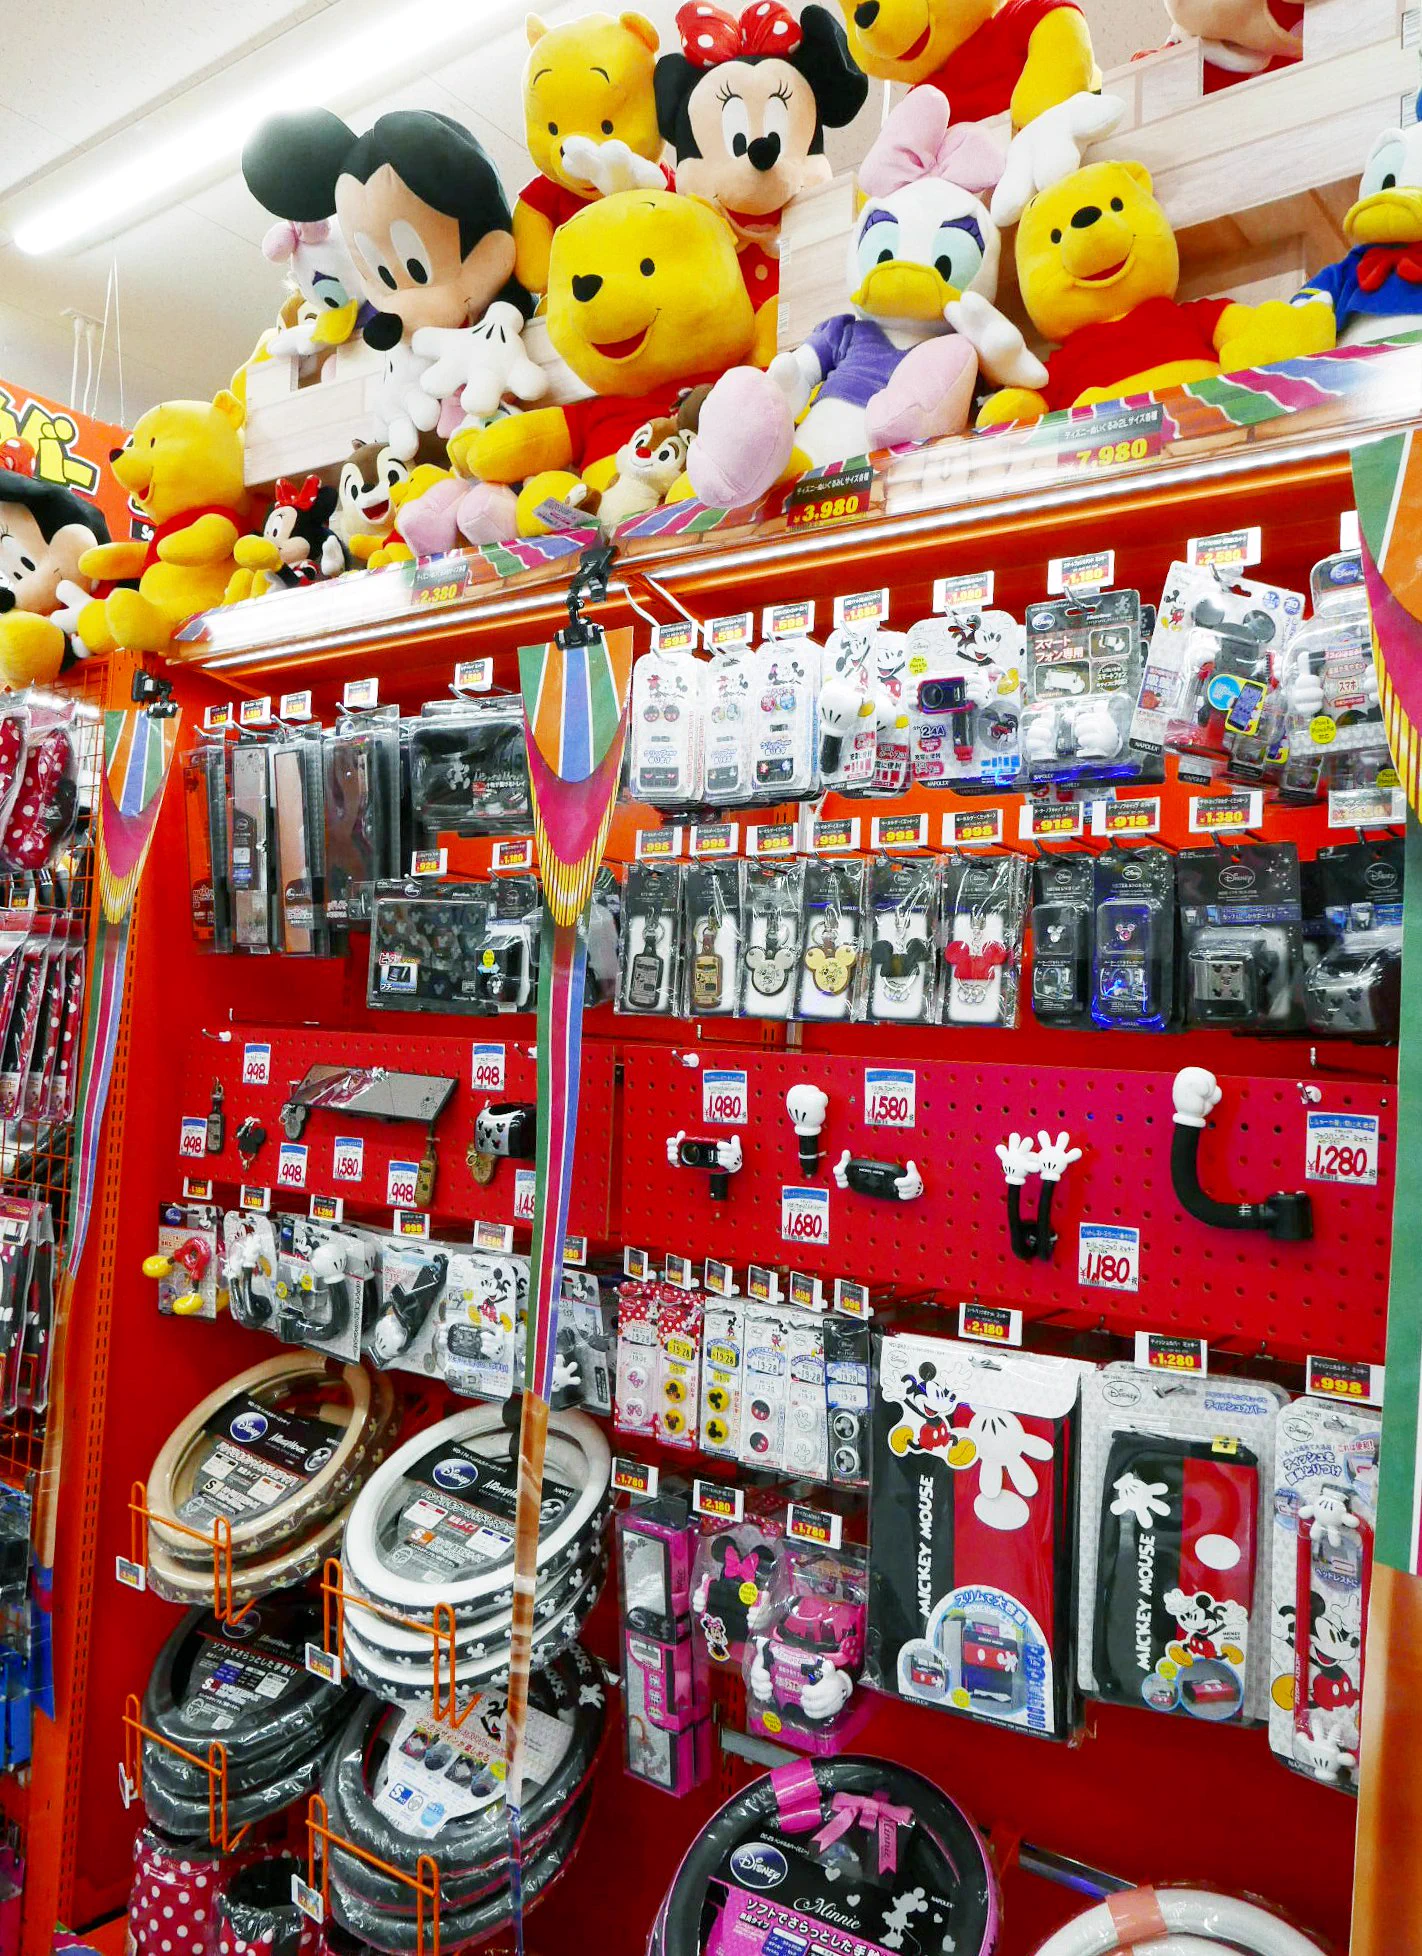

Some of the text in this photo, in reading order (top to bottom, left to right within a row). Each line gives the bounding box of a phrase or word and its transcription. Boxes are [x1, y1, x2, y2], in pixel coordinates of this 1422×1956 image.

[1035, 635, 1072, 650] スマート
[1035, 646, 1084, 663] フォン専用
[1339, 680, 1357, 692] スマホ
[1220, 870, 1253, 884] Disney
[1367, 869, 1396, 881] Disney
[247, 1063, 265, 1081] 998
[476, 1065, 500, 1086] 998
[183, 1136, 202, 1154] 998
[282, 1162, 302, 1183] 998
[391, 1182, 414, 1203] 998
[1107, 1384, 1138, 1401] Disney
[1287, 1423, 1312, 1440] Disney
[1283, 1451, 1336, 1471] ティッシュを
[440, 1463, 471, 1487] Disney
[917, 1474, 935, 1616] MICKEY MOUSE
[1135, 1532, 1156, 1672] MICKEY MOUSE
[738, 1853, 782, 1884] Disney
[930, 1895, 954, 1908] NAPOLEX
[793, 1897, 862, 1930] Minnie
